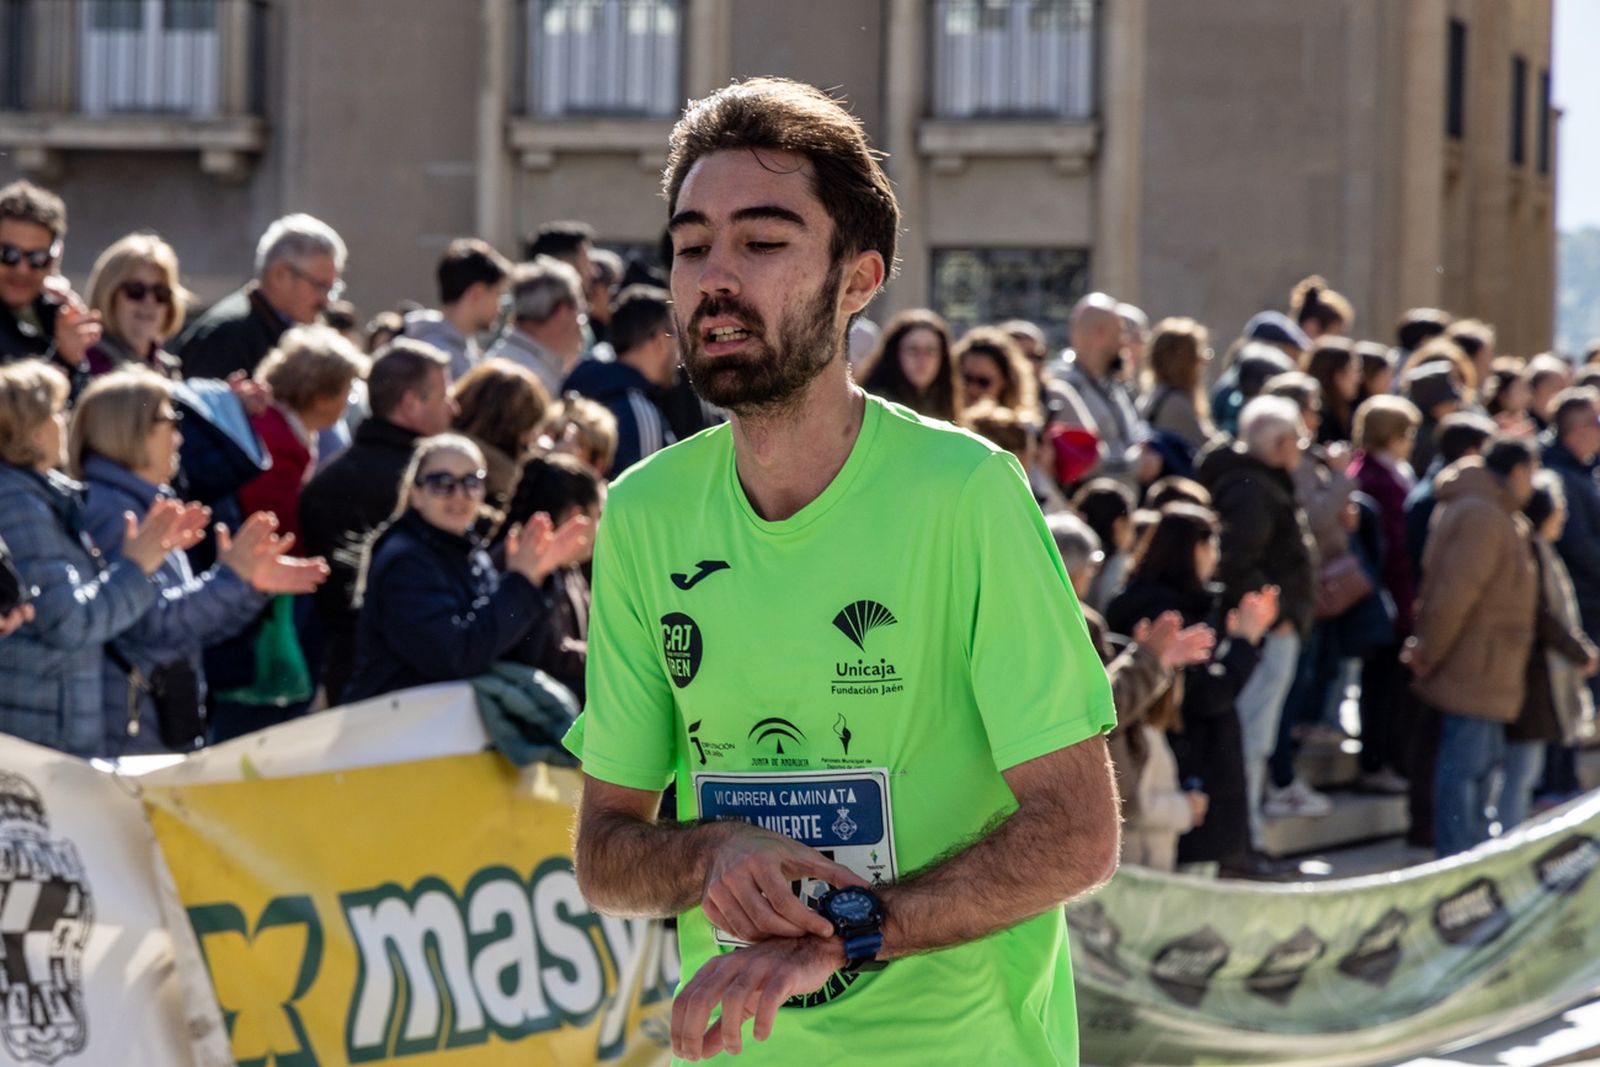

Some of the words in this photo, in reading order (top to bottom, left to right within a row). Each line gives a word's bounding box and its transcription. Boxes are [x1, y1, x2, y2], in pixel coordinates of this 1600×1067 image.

[835, 658, 896, 679] Unicaja
[831, 685, 879, 696] Fundación
[881, 683, 904, 696] Jaén
[724, 791, 777, 806] CARRERA
[779, 787, 857, 806] CAMINATA
